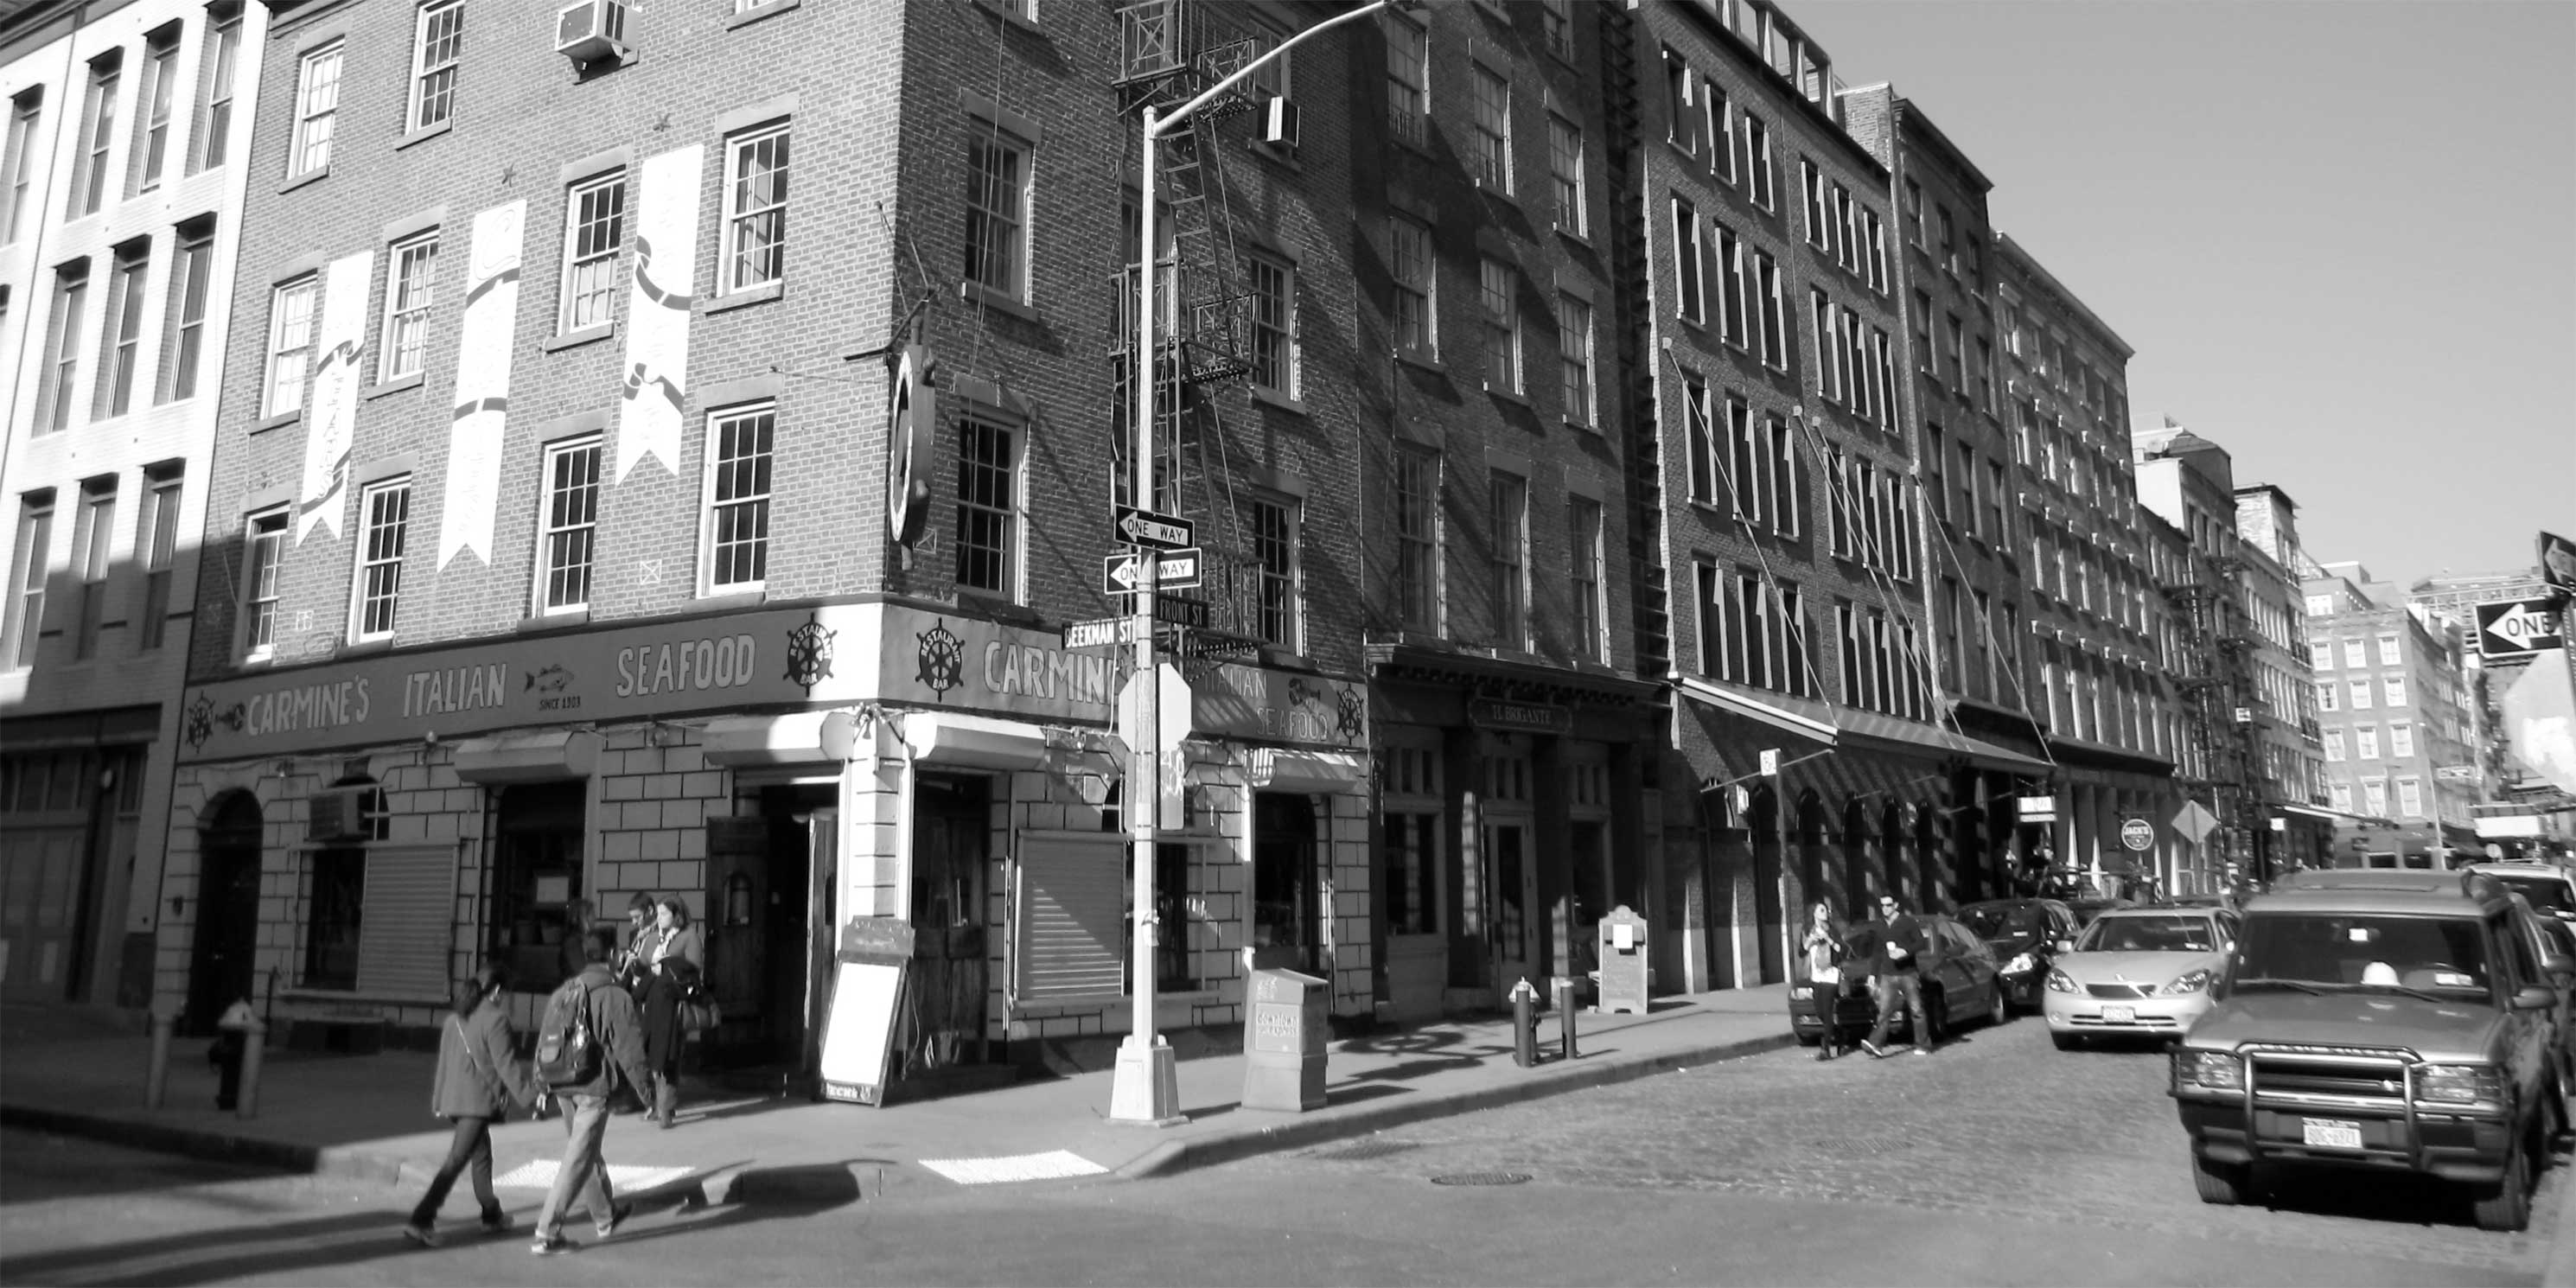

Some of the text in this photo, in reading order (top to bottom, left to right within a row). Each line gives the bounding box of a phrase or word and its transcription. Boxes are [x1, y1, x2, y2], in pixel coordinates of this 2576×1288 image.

[1127, 519, 1184, 543] ONE WAY
[1120, 560, 1188, 581] ON WAY
[1160, 600, 1203, 626] FRONT ST
[2506, 615, 2553, 635] ONE
[789, 624, 832, 660] RESTAURANT
[1065, 620, 1132, 647] BEEKMAN ST
[921, 630, 961, 664] RESTAURANT
[247, 673, 372, 736] CARMINE'S
[404, 662, 509, 718] ITALIAN
[615, 633, 757, 698] SEAFOOD
[800, 673, 818, 685] BAR
[933, 678, 949, 690] BAR
[1257, 706, 1329, 742] SEAFOOD
